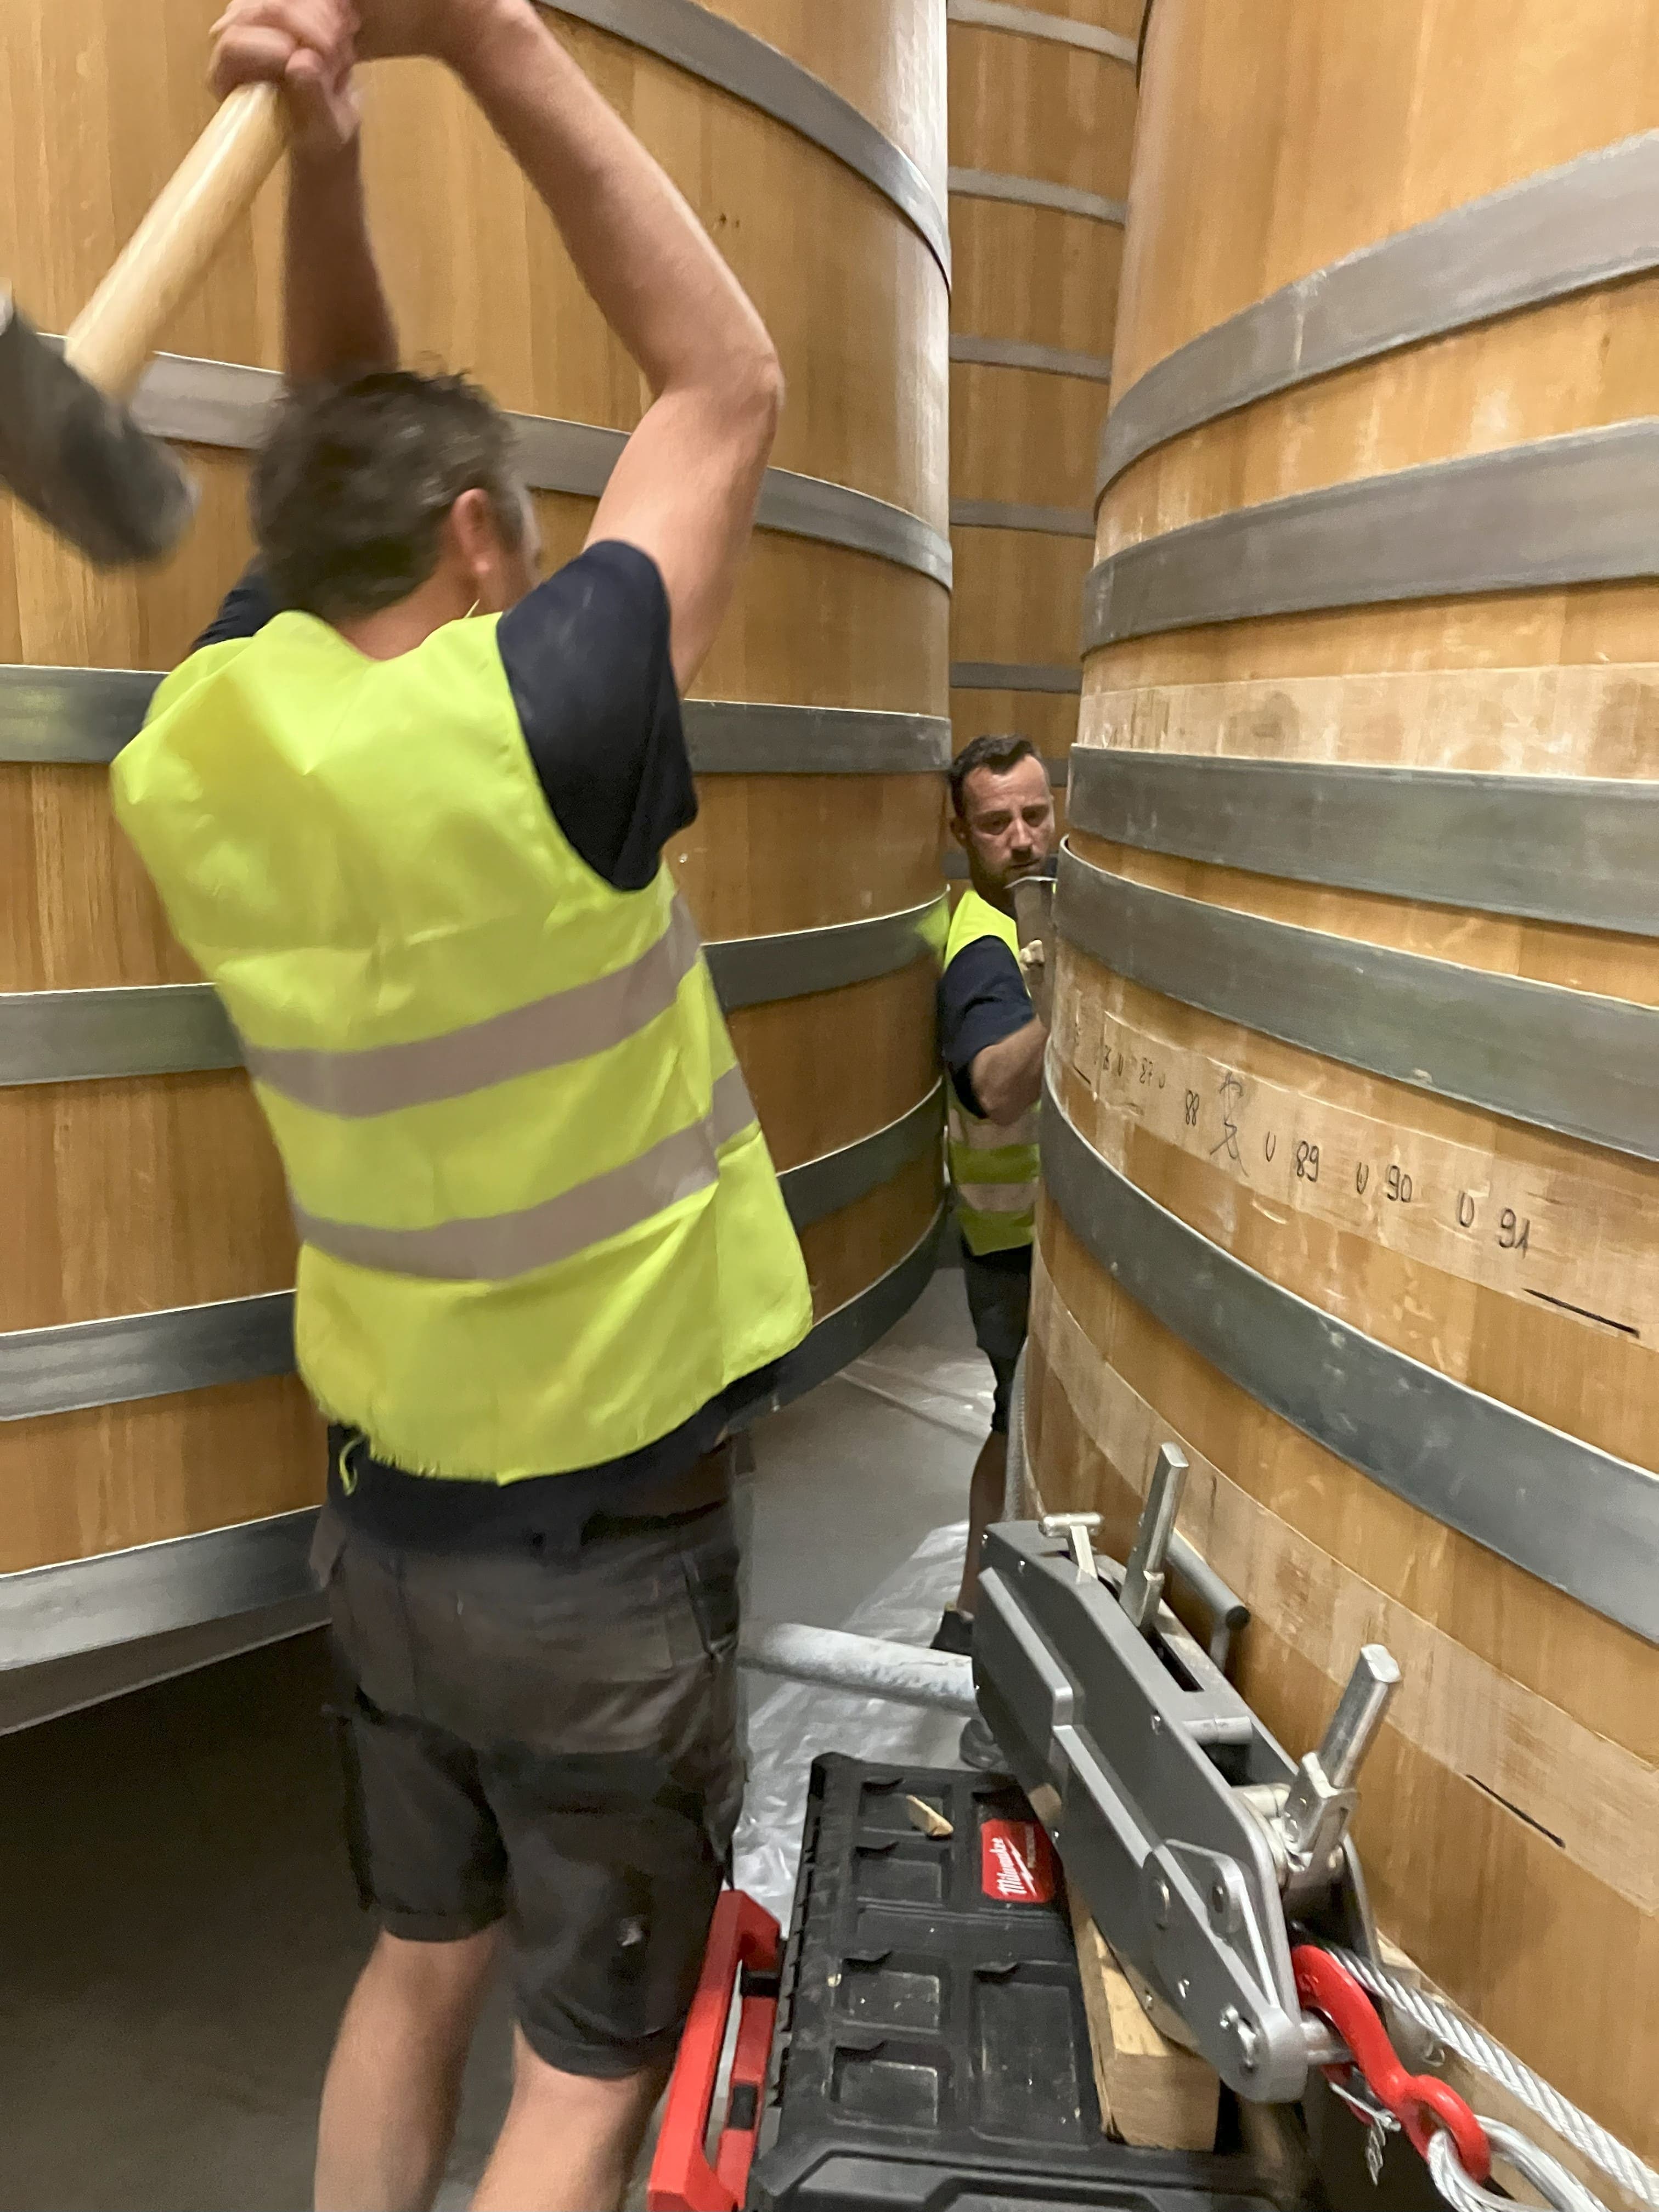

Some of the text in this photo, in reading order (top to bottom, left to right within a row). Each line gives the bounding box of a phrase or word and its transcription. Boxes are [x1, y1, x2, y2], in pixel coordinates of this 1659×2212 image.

[1185, 1090, 1200, 1127] 88
[1295, 1141, 1320, 1182] 89
[1386, 1165, 1413, 1203] 90
[1498, 1208, 1530, 1259] 91
[989, 1837, 1028, 1895] Milwaukee
